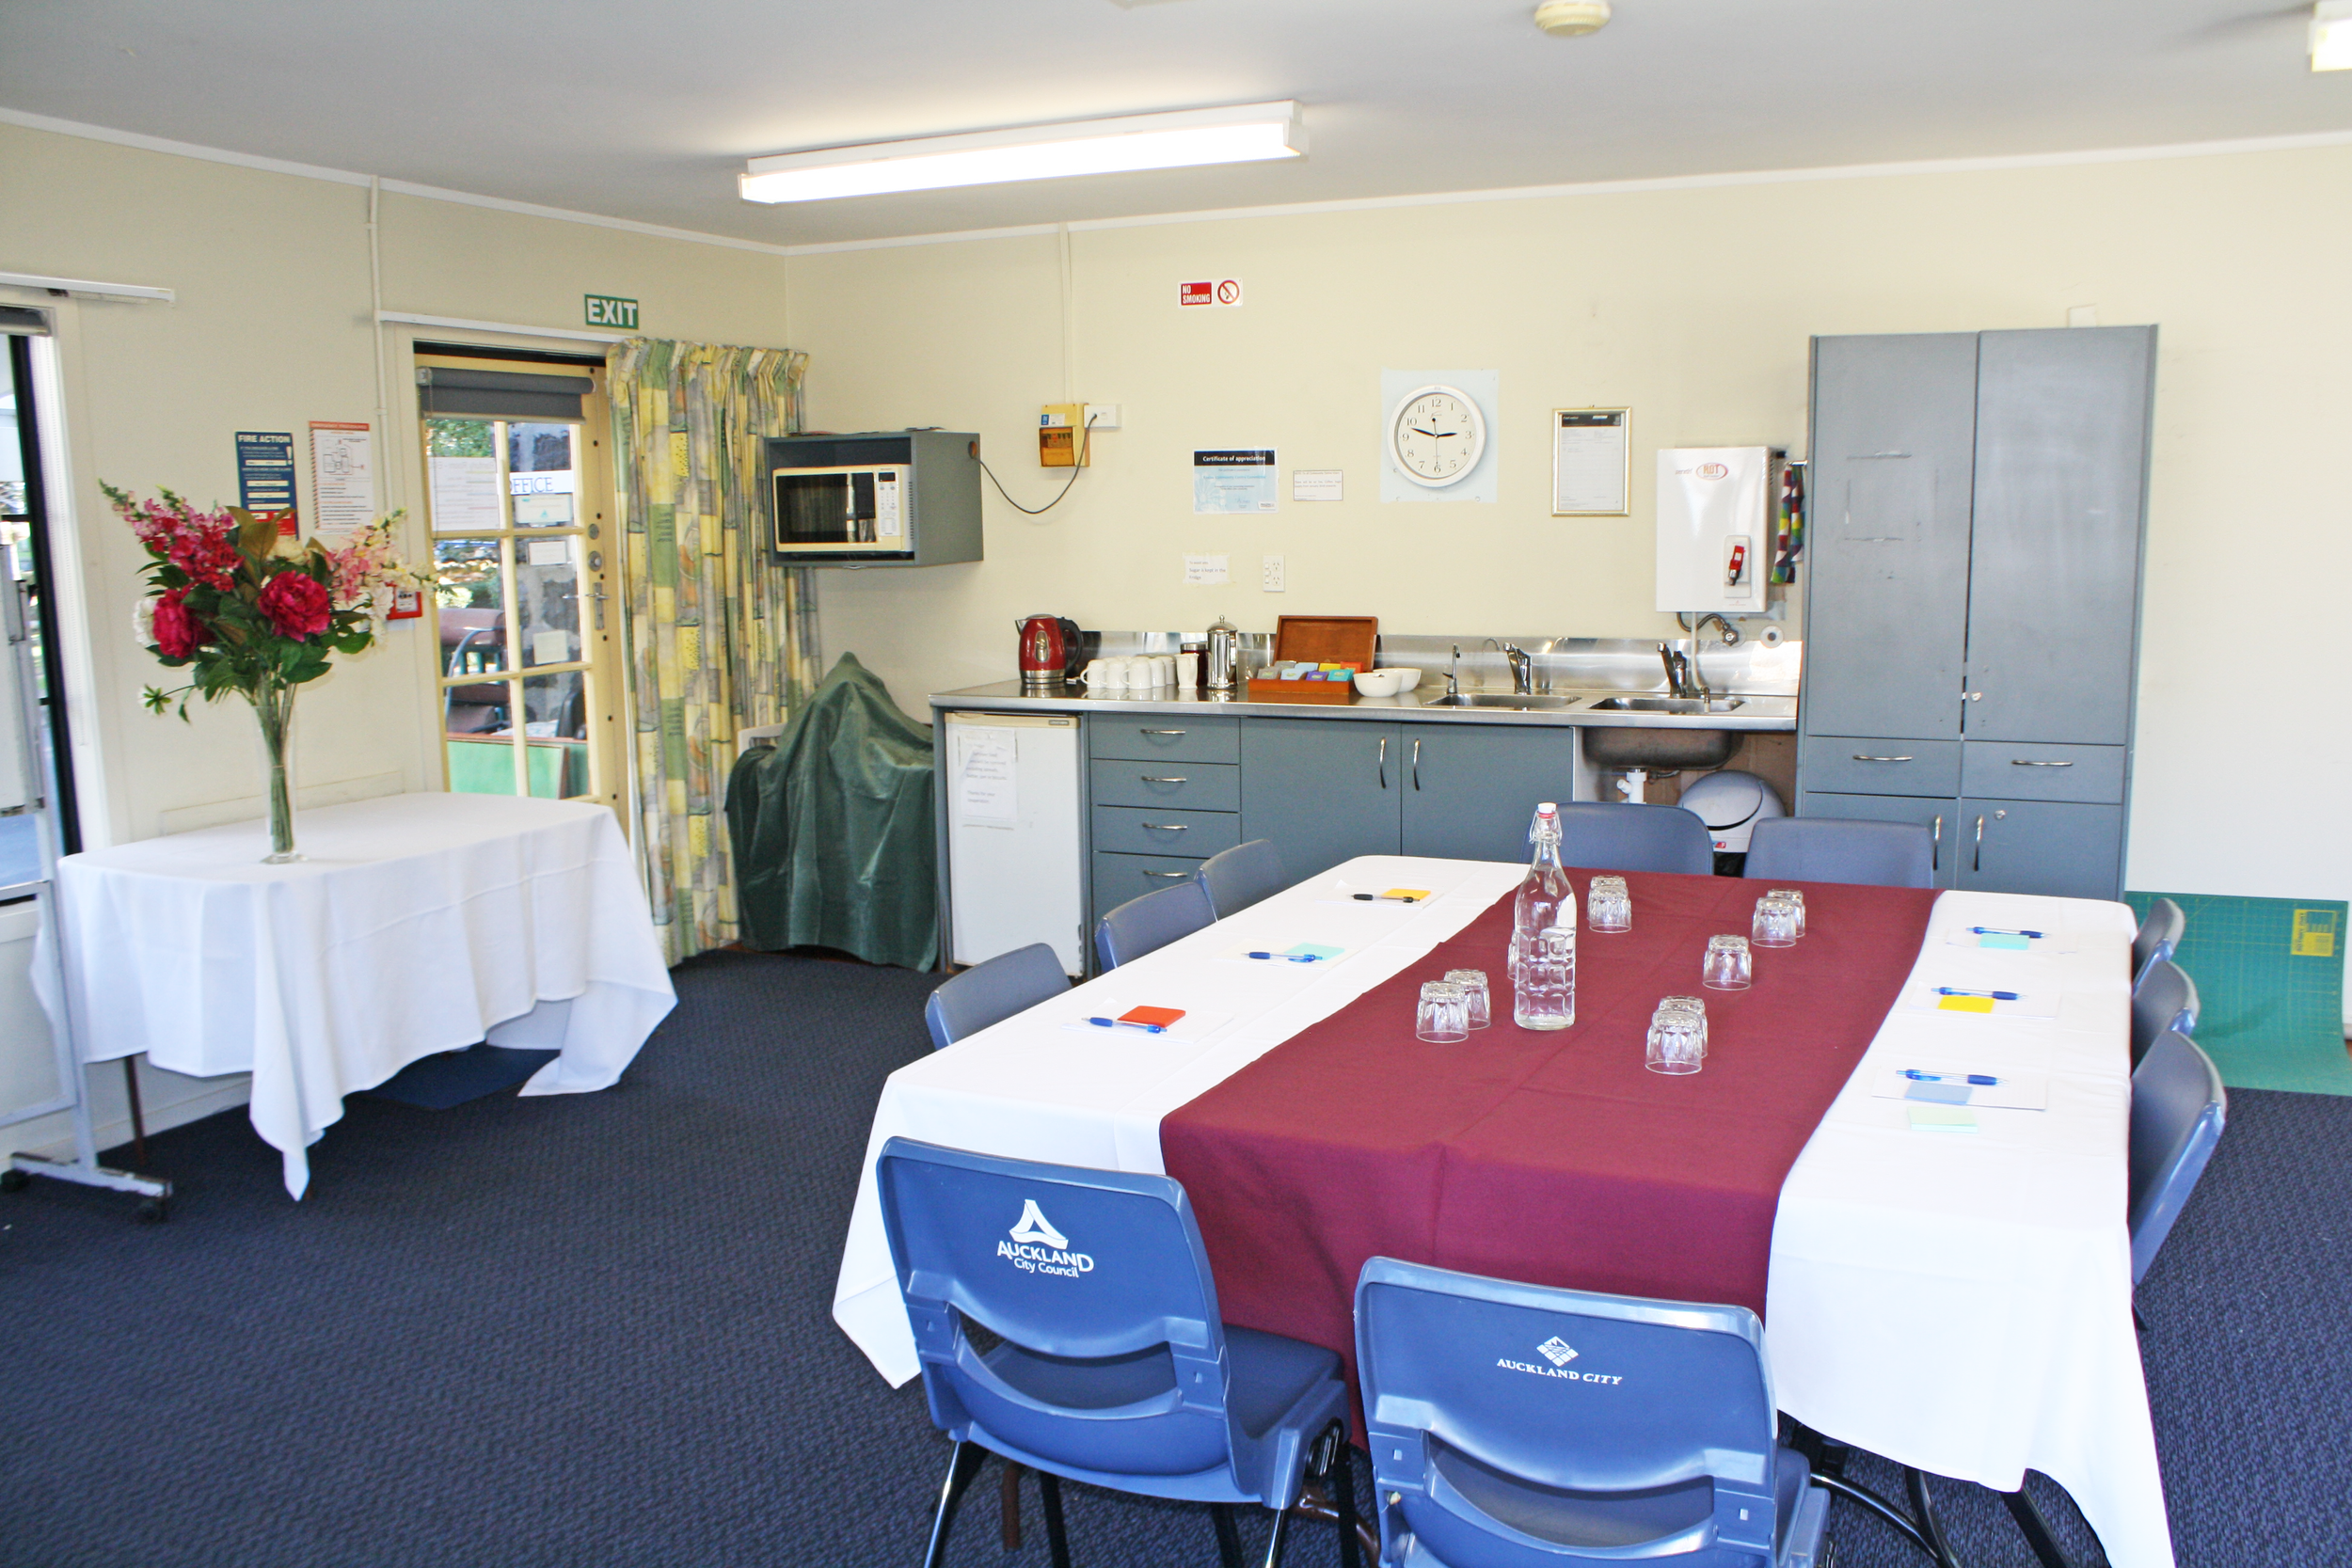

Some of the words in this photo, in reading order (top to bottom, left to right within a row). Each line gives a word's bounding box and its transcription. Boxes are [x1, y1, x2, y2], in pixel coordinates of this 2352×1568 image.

[1183, 285, 1192, 294] NO
[1183, 293, 1211, 304] SMOKING
[587, 297, 637, 326] EXIT
[1431, 399, 1442, 407] 12
[1407, 417, 1417, 426] 10
[1461, 414, 1469, 422] 2
[1465, 431, 1472, 439] 3
[1407, 449, 1414, 457] 8
[1461, 448, 1467, 456] 4
[1419, 461, 1425, 469] 7
[1449, 460, 1456, 468] 5
[1434, 465, 1441, 473] 6
[1703, 465, 1720, 474] HOT
[510, 477, 554, 493] FFICE
[997, 1240, 1094, 1272] AUCKLAND
[1014, 1258, 1036, 1273] City
[1038, 1262, 1079, 1278] Council
[1497, 1358, 1580, 1380] AUCKLAND
[1582, 1373, 1623, 1385] CITY
